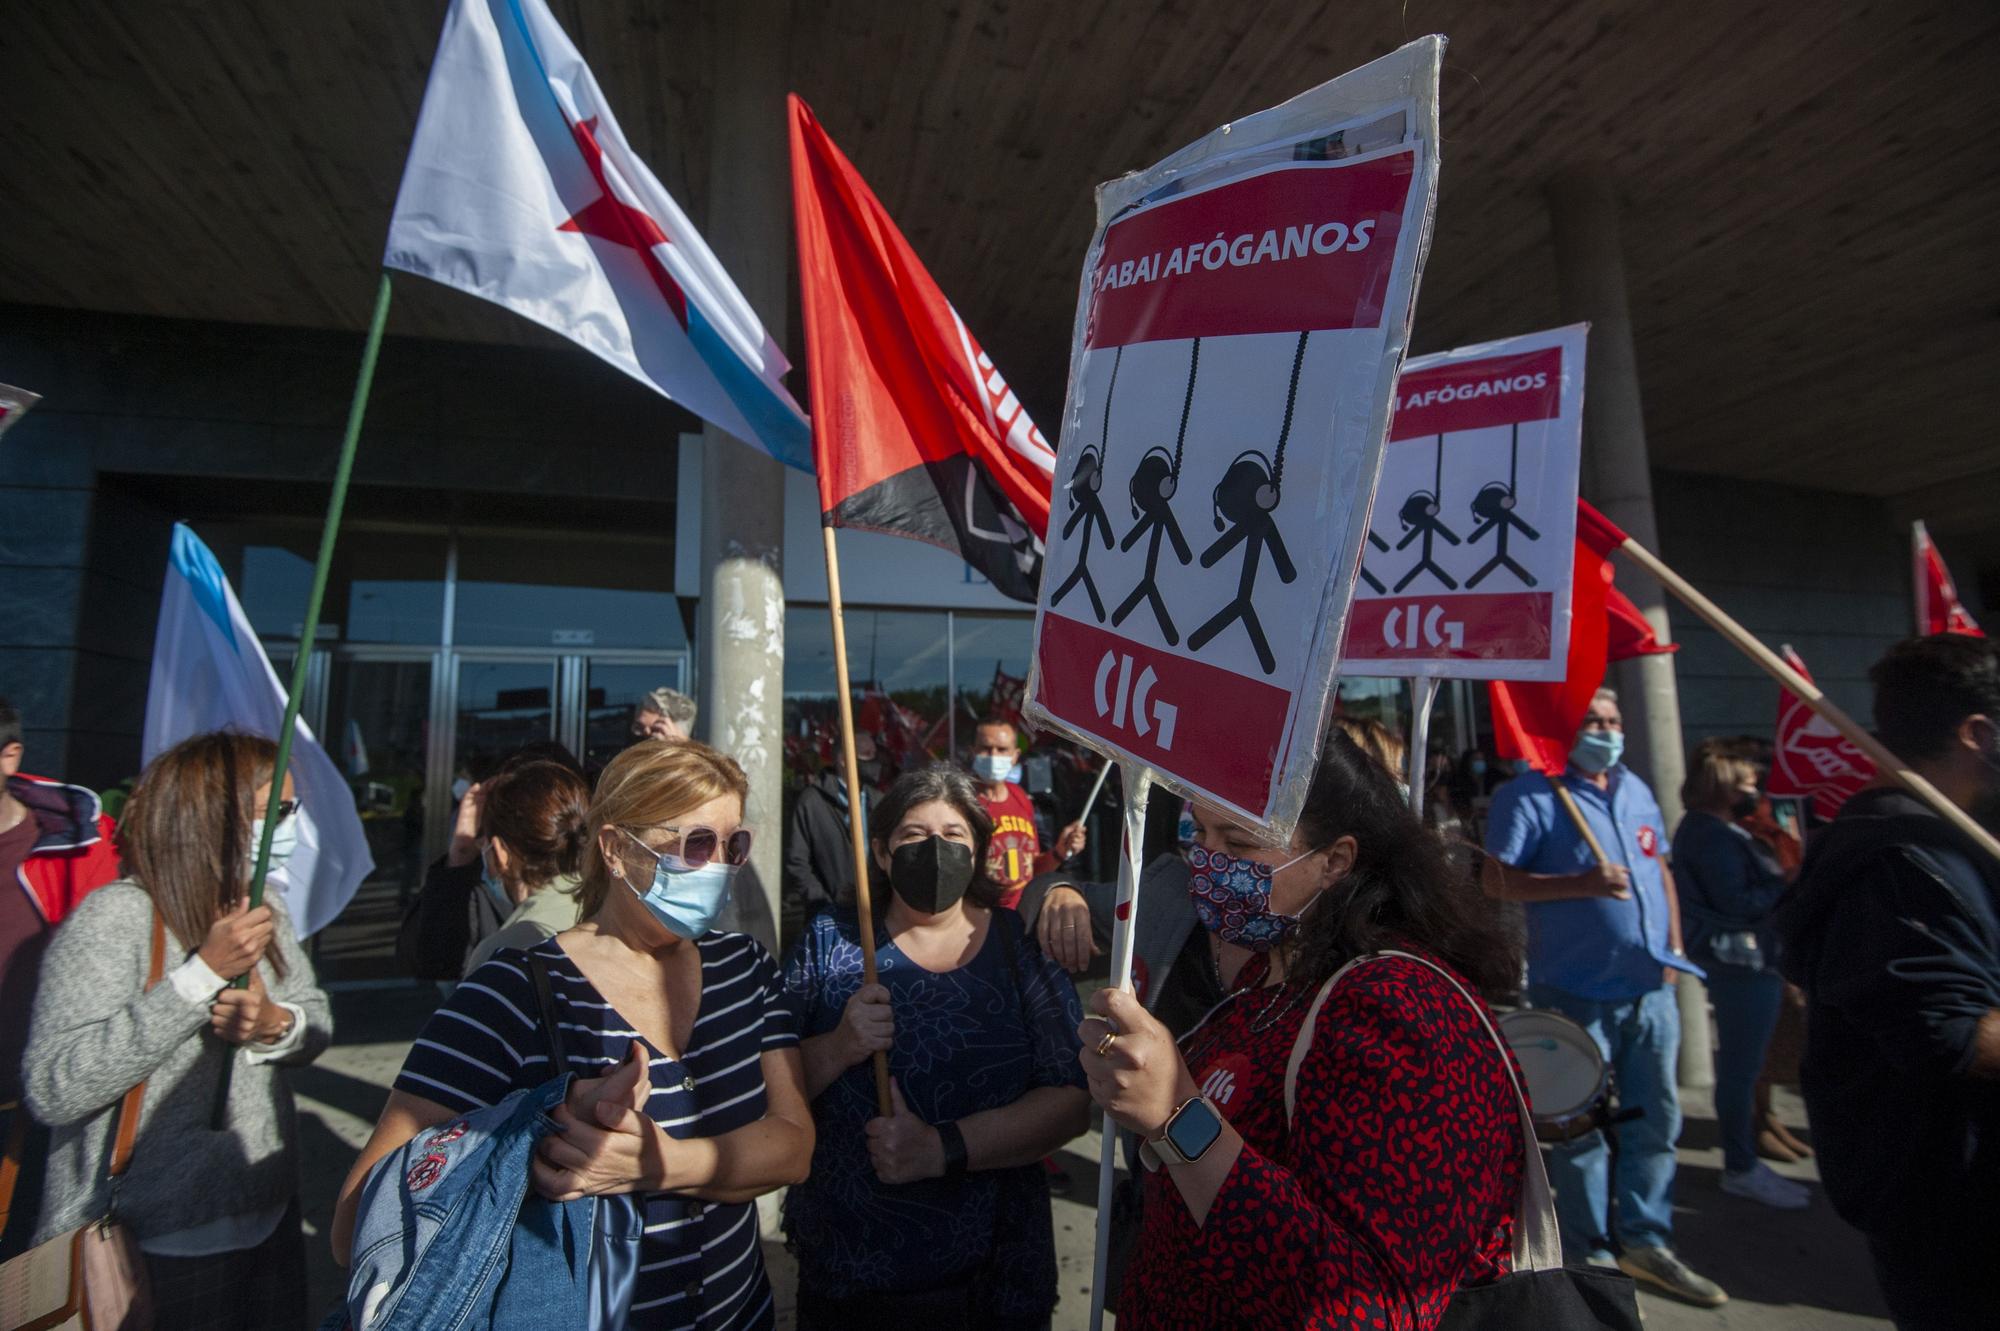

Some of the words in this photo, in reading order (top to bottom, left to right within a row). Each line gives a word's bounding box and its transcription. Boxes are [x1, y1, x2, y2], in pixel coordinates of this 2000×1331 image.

[1163, 219, 1376, 279] AFÓGANOS
[1405, 372, 1547, 410] AFÓGANOS
[1383, 604, 1465, 649] CIG
[1094, 649, 1178, 751] CIG
[1202, 1069, 1236, 1104] CIG
